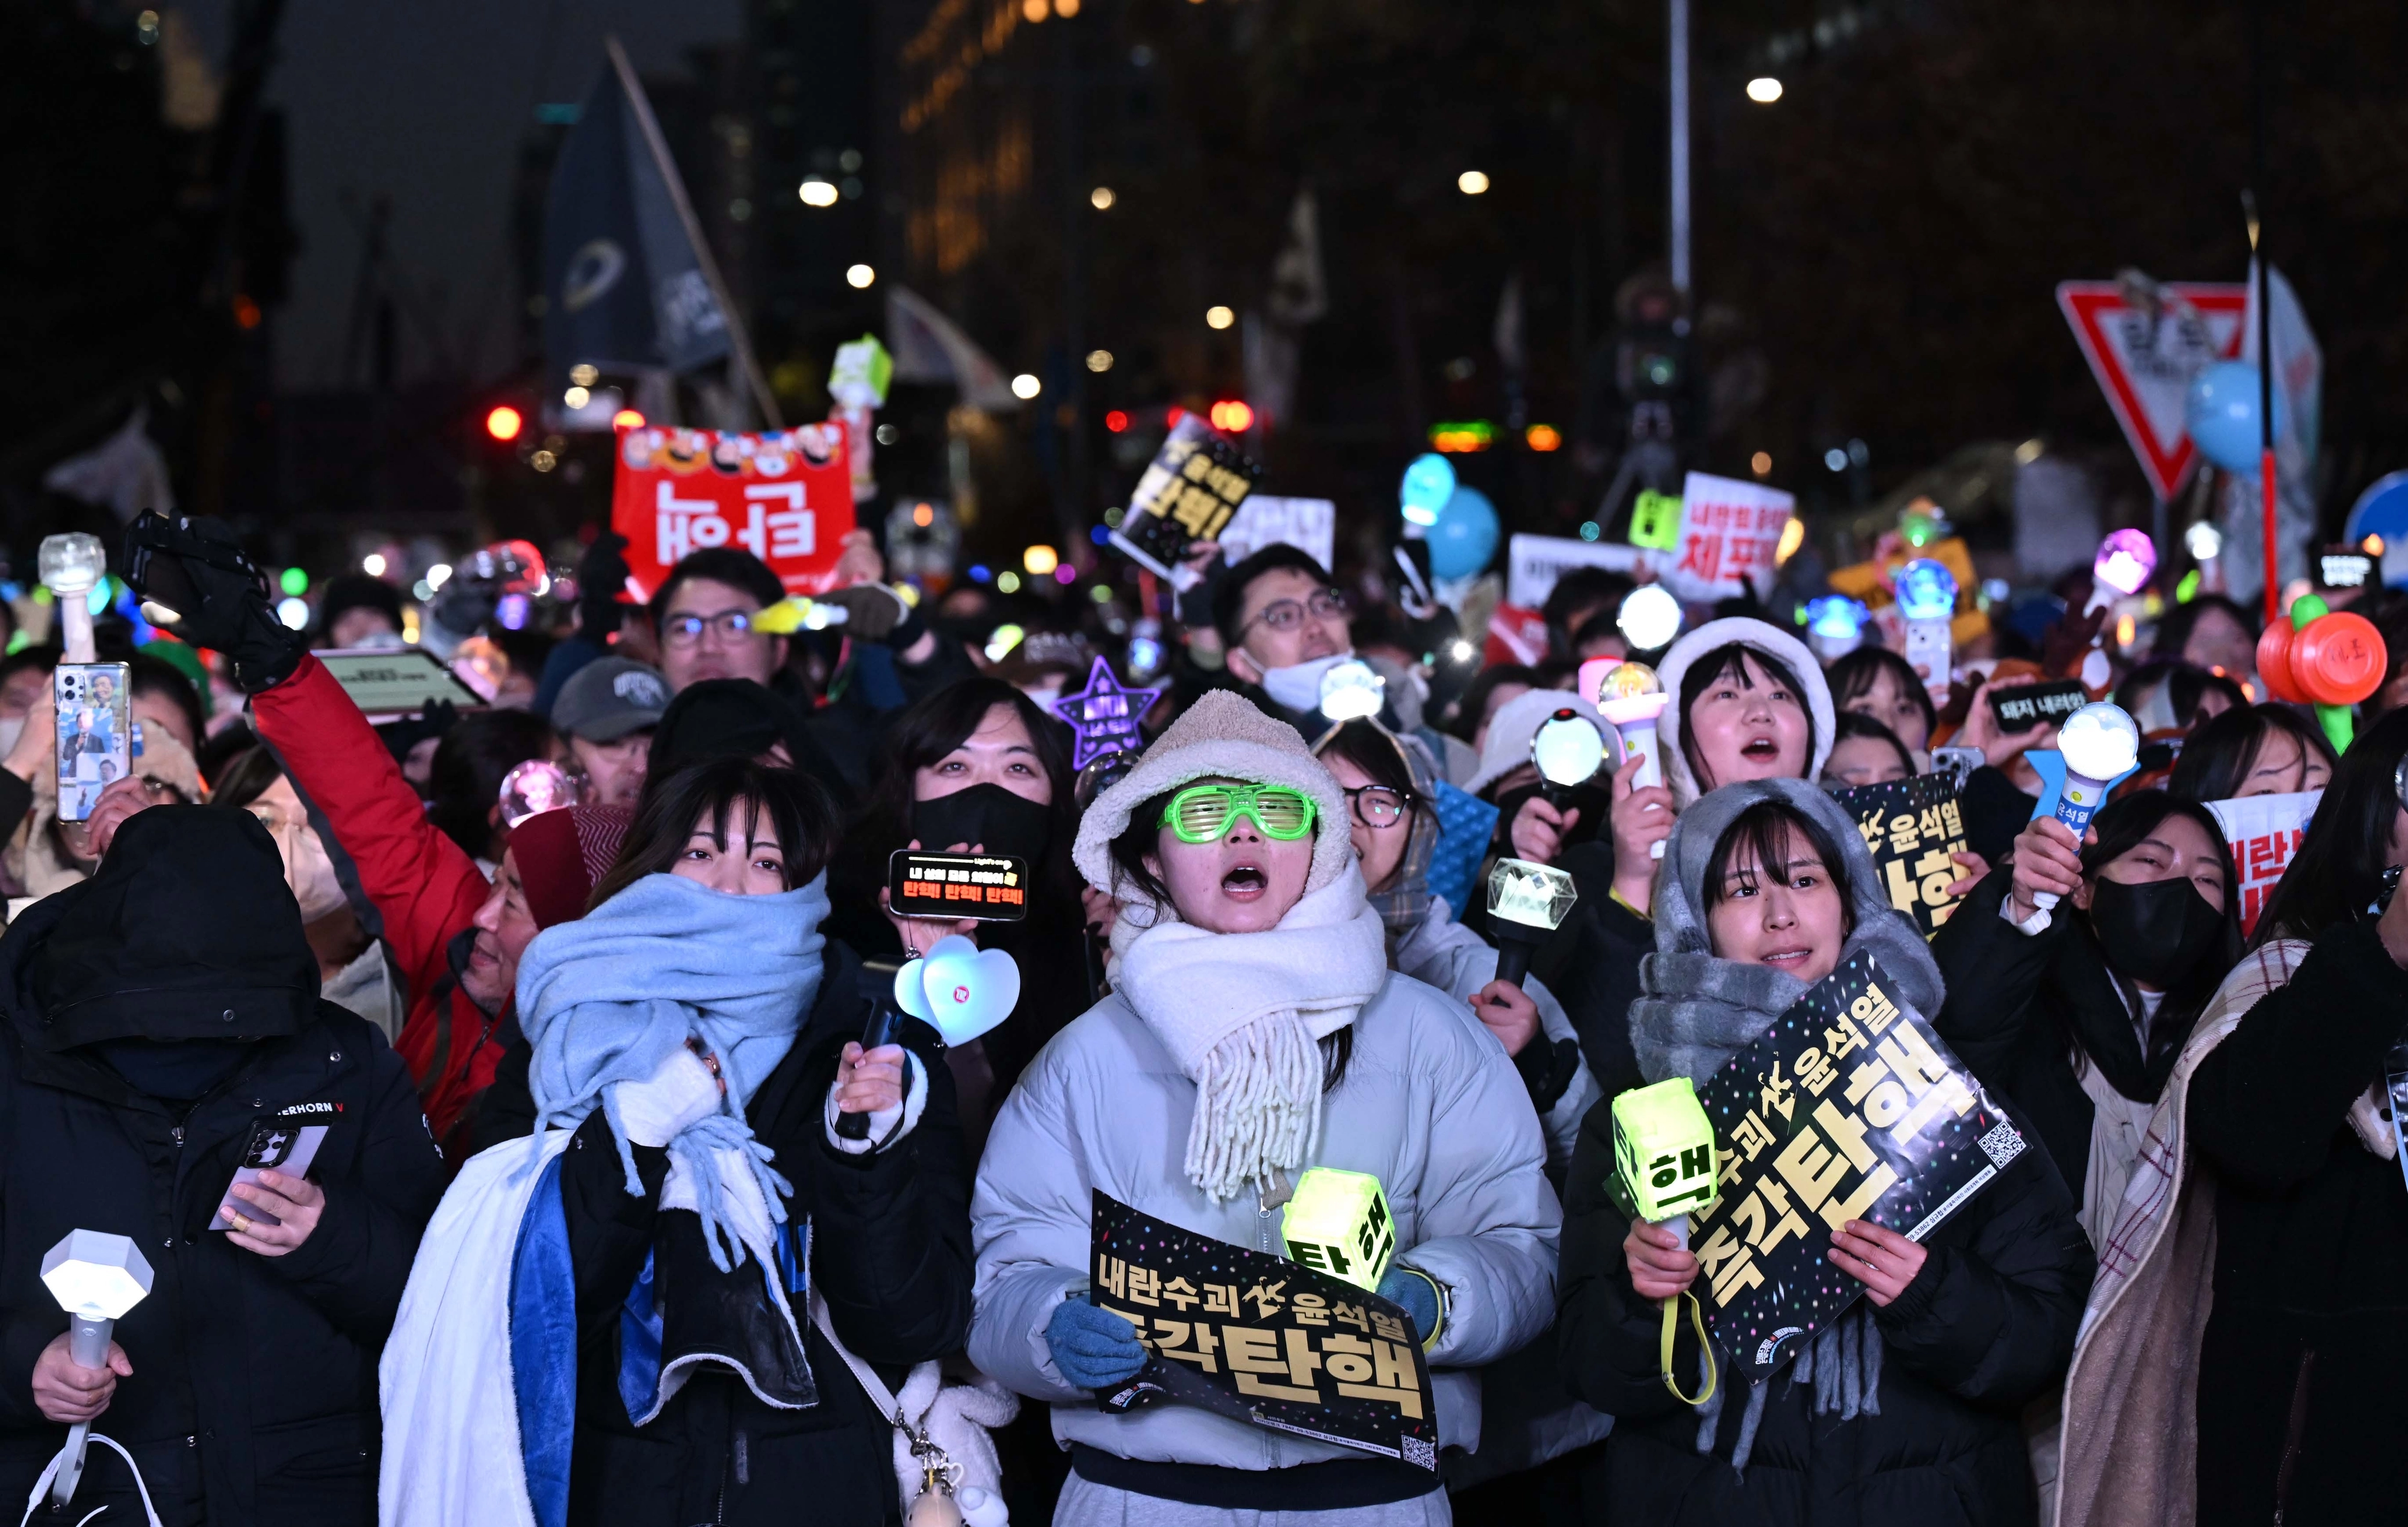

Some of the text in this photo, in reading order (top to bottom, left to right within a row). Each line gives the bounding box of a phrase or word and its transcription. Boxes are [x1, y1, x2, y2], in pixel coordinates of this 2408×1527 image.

[656, 481, 815, 565] 탄핵
[1889, 798, 1964, 854] 윤석열
[2057, 802, 2089, 823] 윤석열
[2229, 828, 2304, 884] 내란
[904, 881, 1023, 905] 탄핵! 탄핵! 탄핵!
[1793, 982, 1899, 1095] 윤석열
[278, 1103, 344, 1115] ERHORN V
[1649, 1144, 1711, 1209] 핵
[1099, 1253, 1409, 1343] 내란수괴 윤석열
